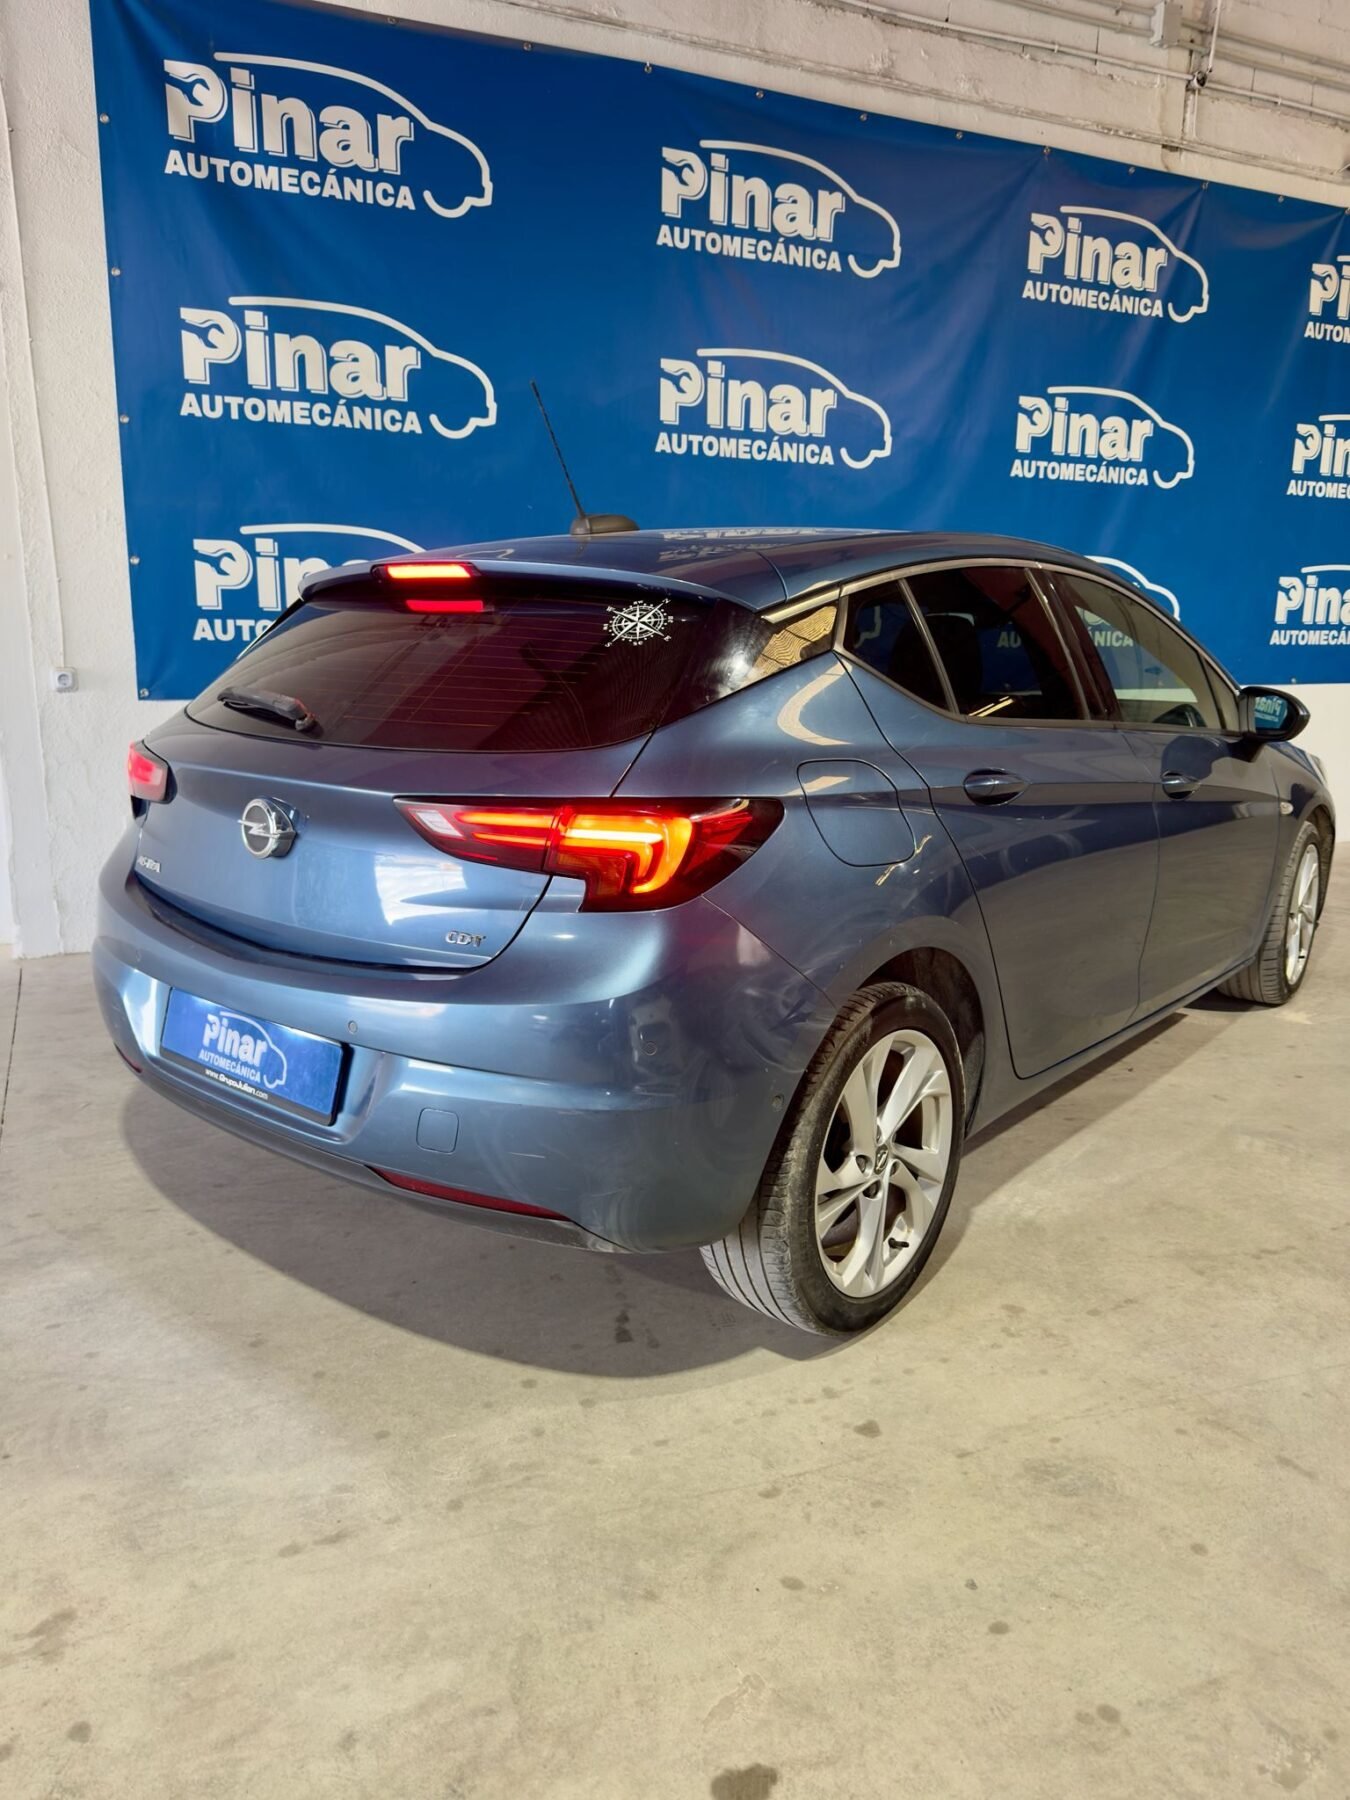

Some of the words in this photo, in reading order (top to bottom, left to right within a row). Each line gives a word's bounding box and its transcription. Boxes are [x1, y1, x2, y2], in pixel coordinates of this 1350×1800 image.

[164, 60, 414, 176] Pinar
[165, 150, 415, 211] AUTOMECÁNICA
[662, 147, 845, 243] Pinar
[657, 225, 842, 272] AUTOMECÁNICA
[1028, 213, 1168, 293] Pinar
[1022, 280, 1164, 317] AUTOMECÁNICA
[180, 307, 421, 402] Pinar
[180, 393, 422, 434] AUTOMECÁNICA
[660, 358, 837, 437] Pinar
[655, 432, 835, 466] AUTOMECÁNICA
[1016, 396, 1154, 461] Pinar
[1011, 459, 1149, 486] AUTOMECÁNICA
[1286, 480, 1350, 499] AUTOME
[1270, 627, 1350, 645] AUTOMECÁ
[203, 1014, 268, 1067] Pinar
[198, 1049, 261, 1083] AUTOMECÁNICA
